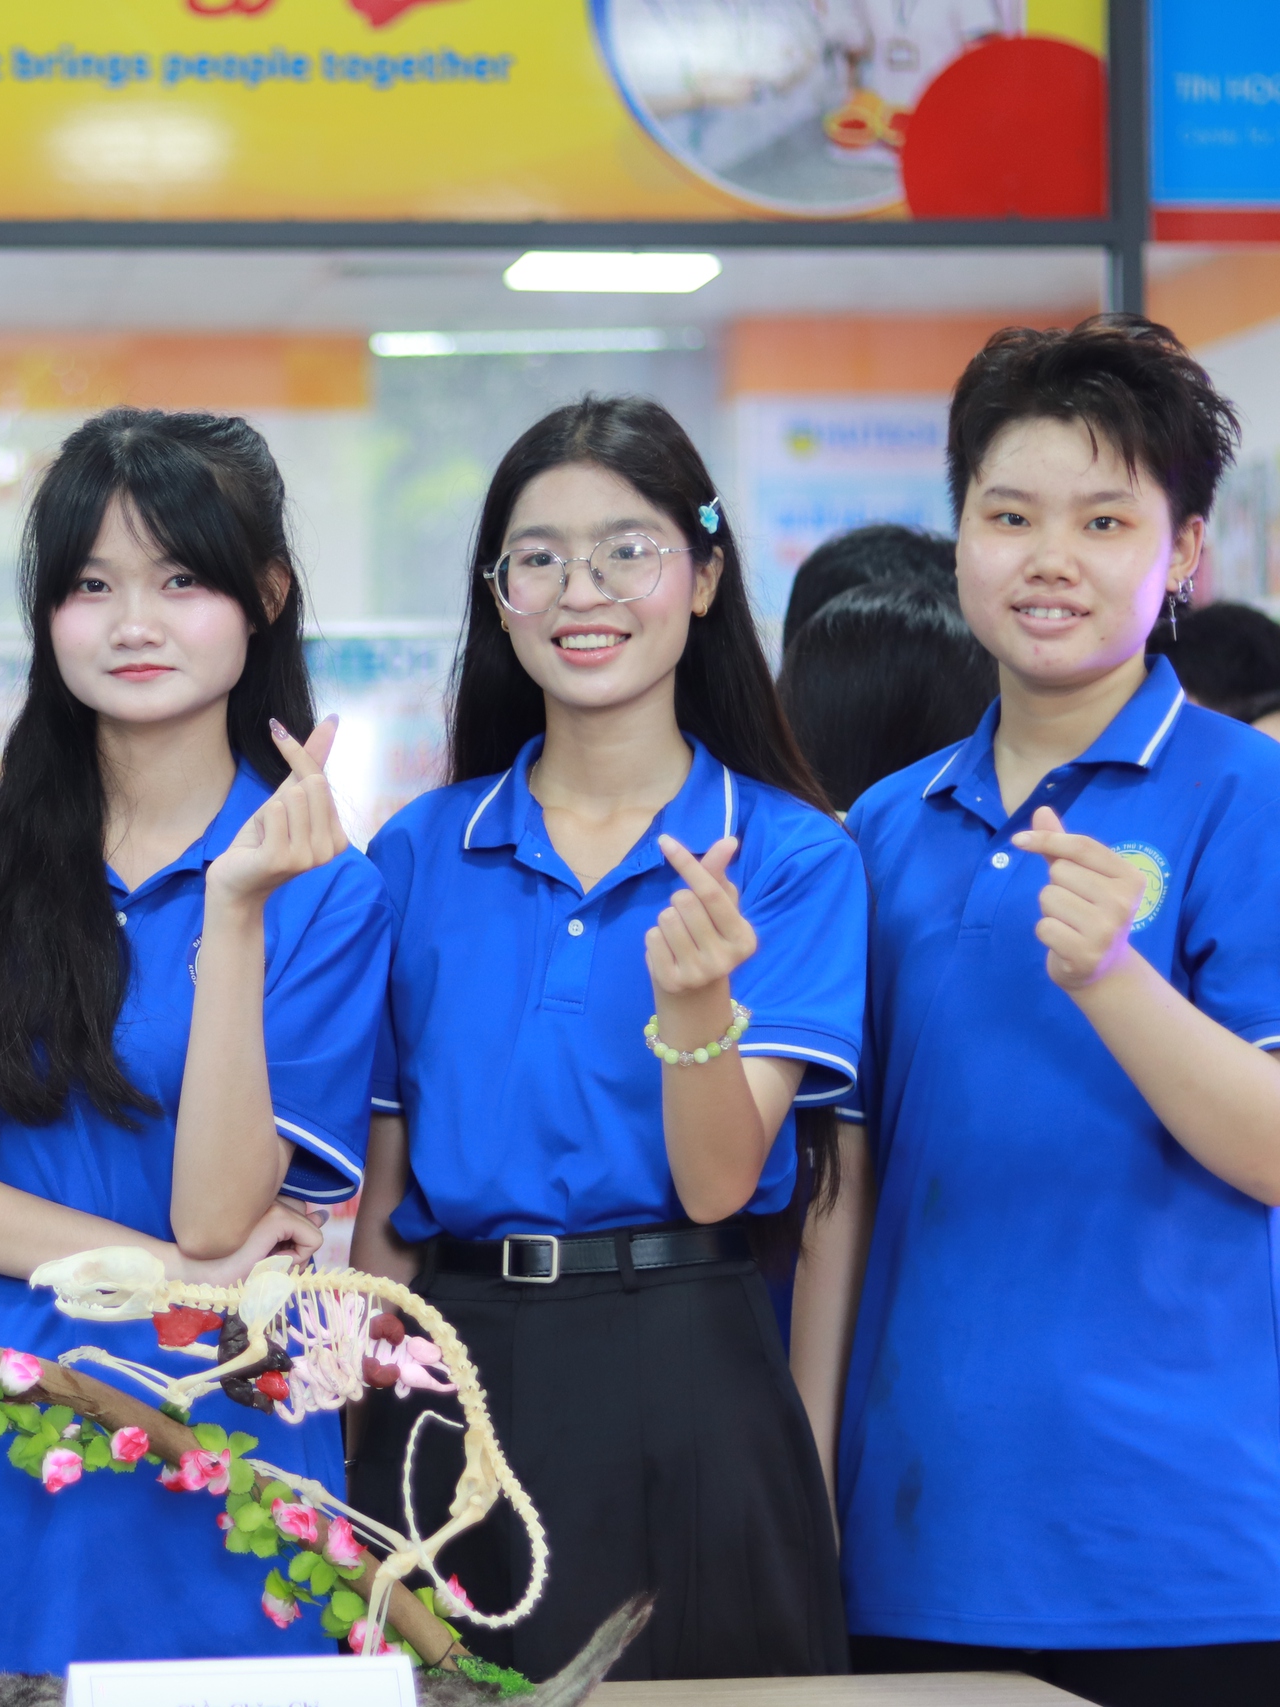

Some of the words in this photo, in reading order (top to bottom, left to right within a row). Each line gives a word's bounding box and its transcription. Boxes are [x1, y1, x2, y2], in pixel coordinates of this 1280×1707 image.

[11, 44, 152, 87] brings
[161, 46, 312, 87] people
[321, 45, 515, 88] together
[1143, 846, 1166, 867] HUTECH
